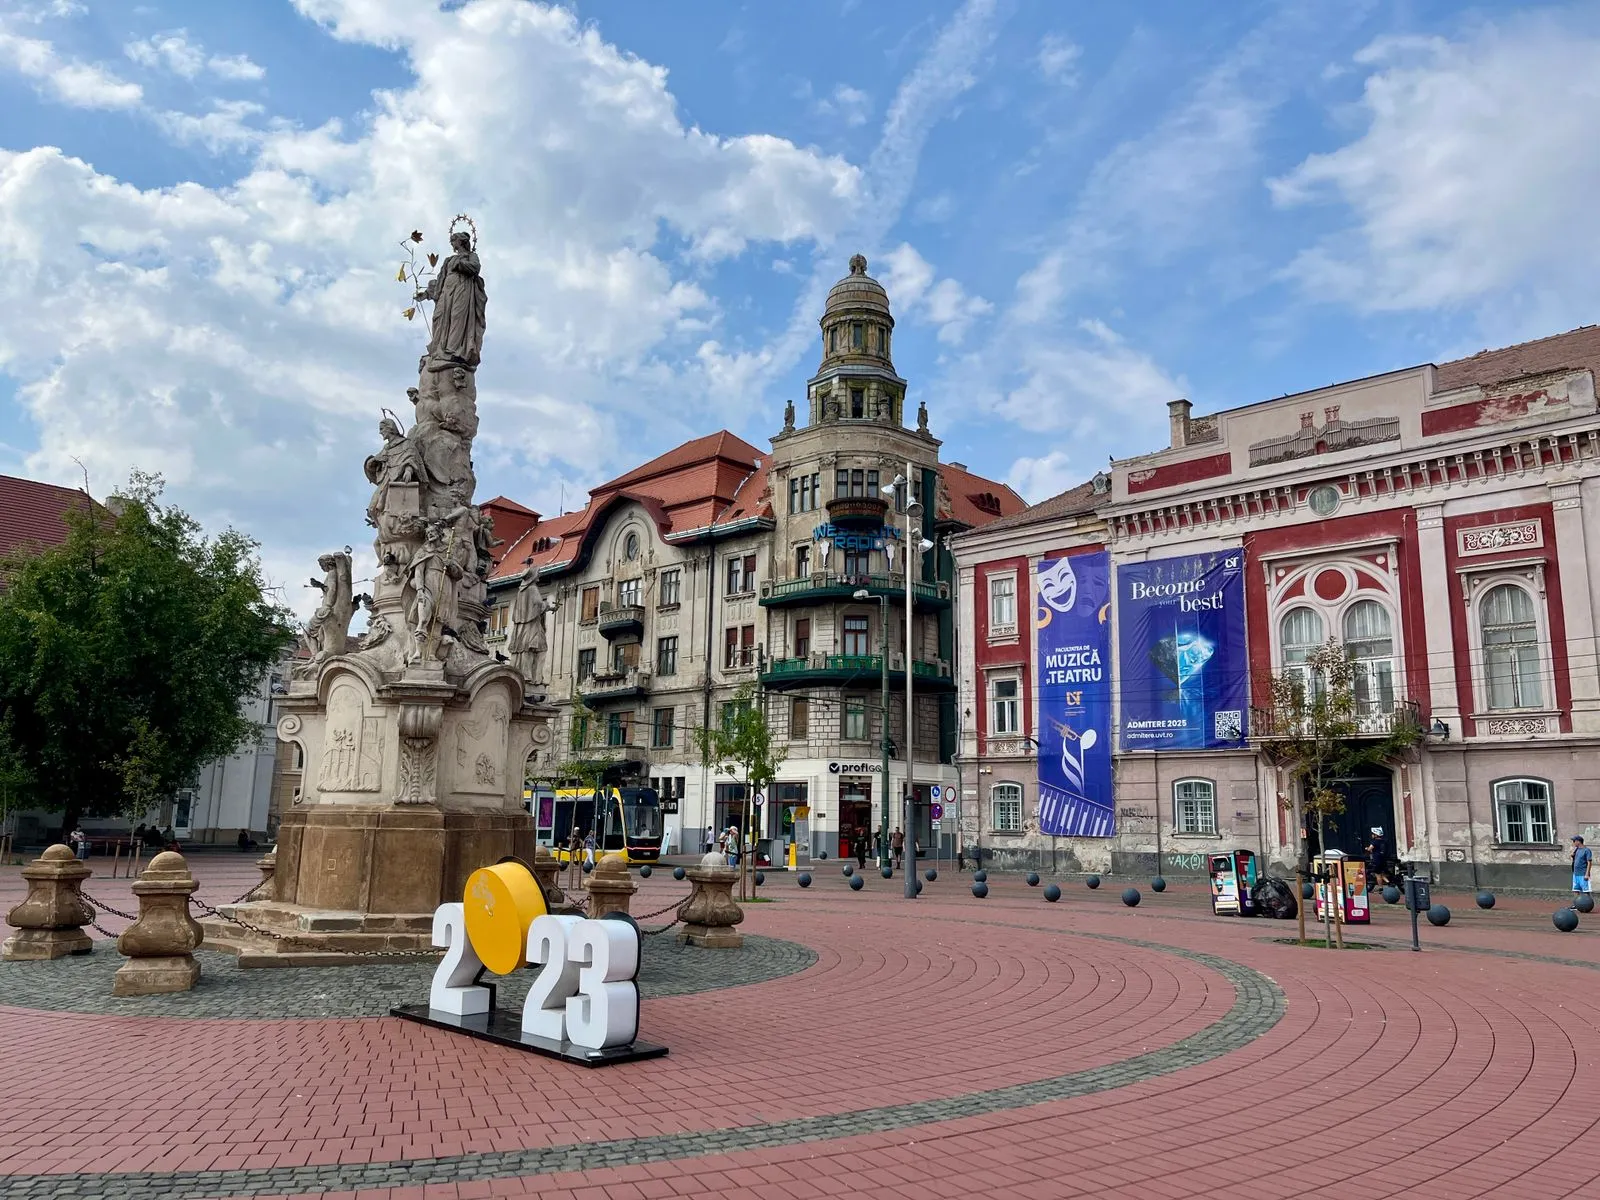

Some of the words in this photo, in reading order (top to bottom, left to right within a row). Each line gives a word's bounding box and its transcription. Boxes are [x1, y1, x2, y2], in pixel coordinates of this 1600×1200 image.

[1131, 578, 1206, 600] Become
[1180, 590, 1224, 613] best!
[1046, 649, 1101, 668] MUZICĂ
[1049, 667, 1102, 684] TEATRU
[1127, 720, 1166, 729] ADMITERE
